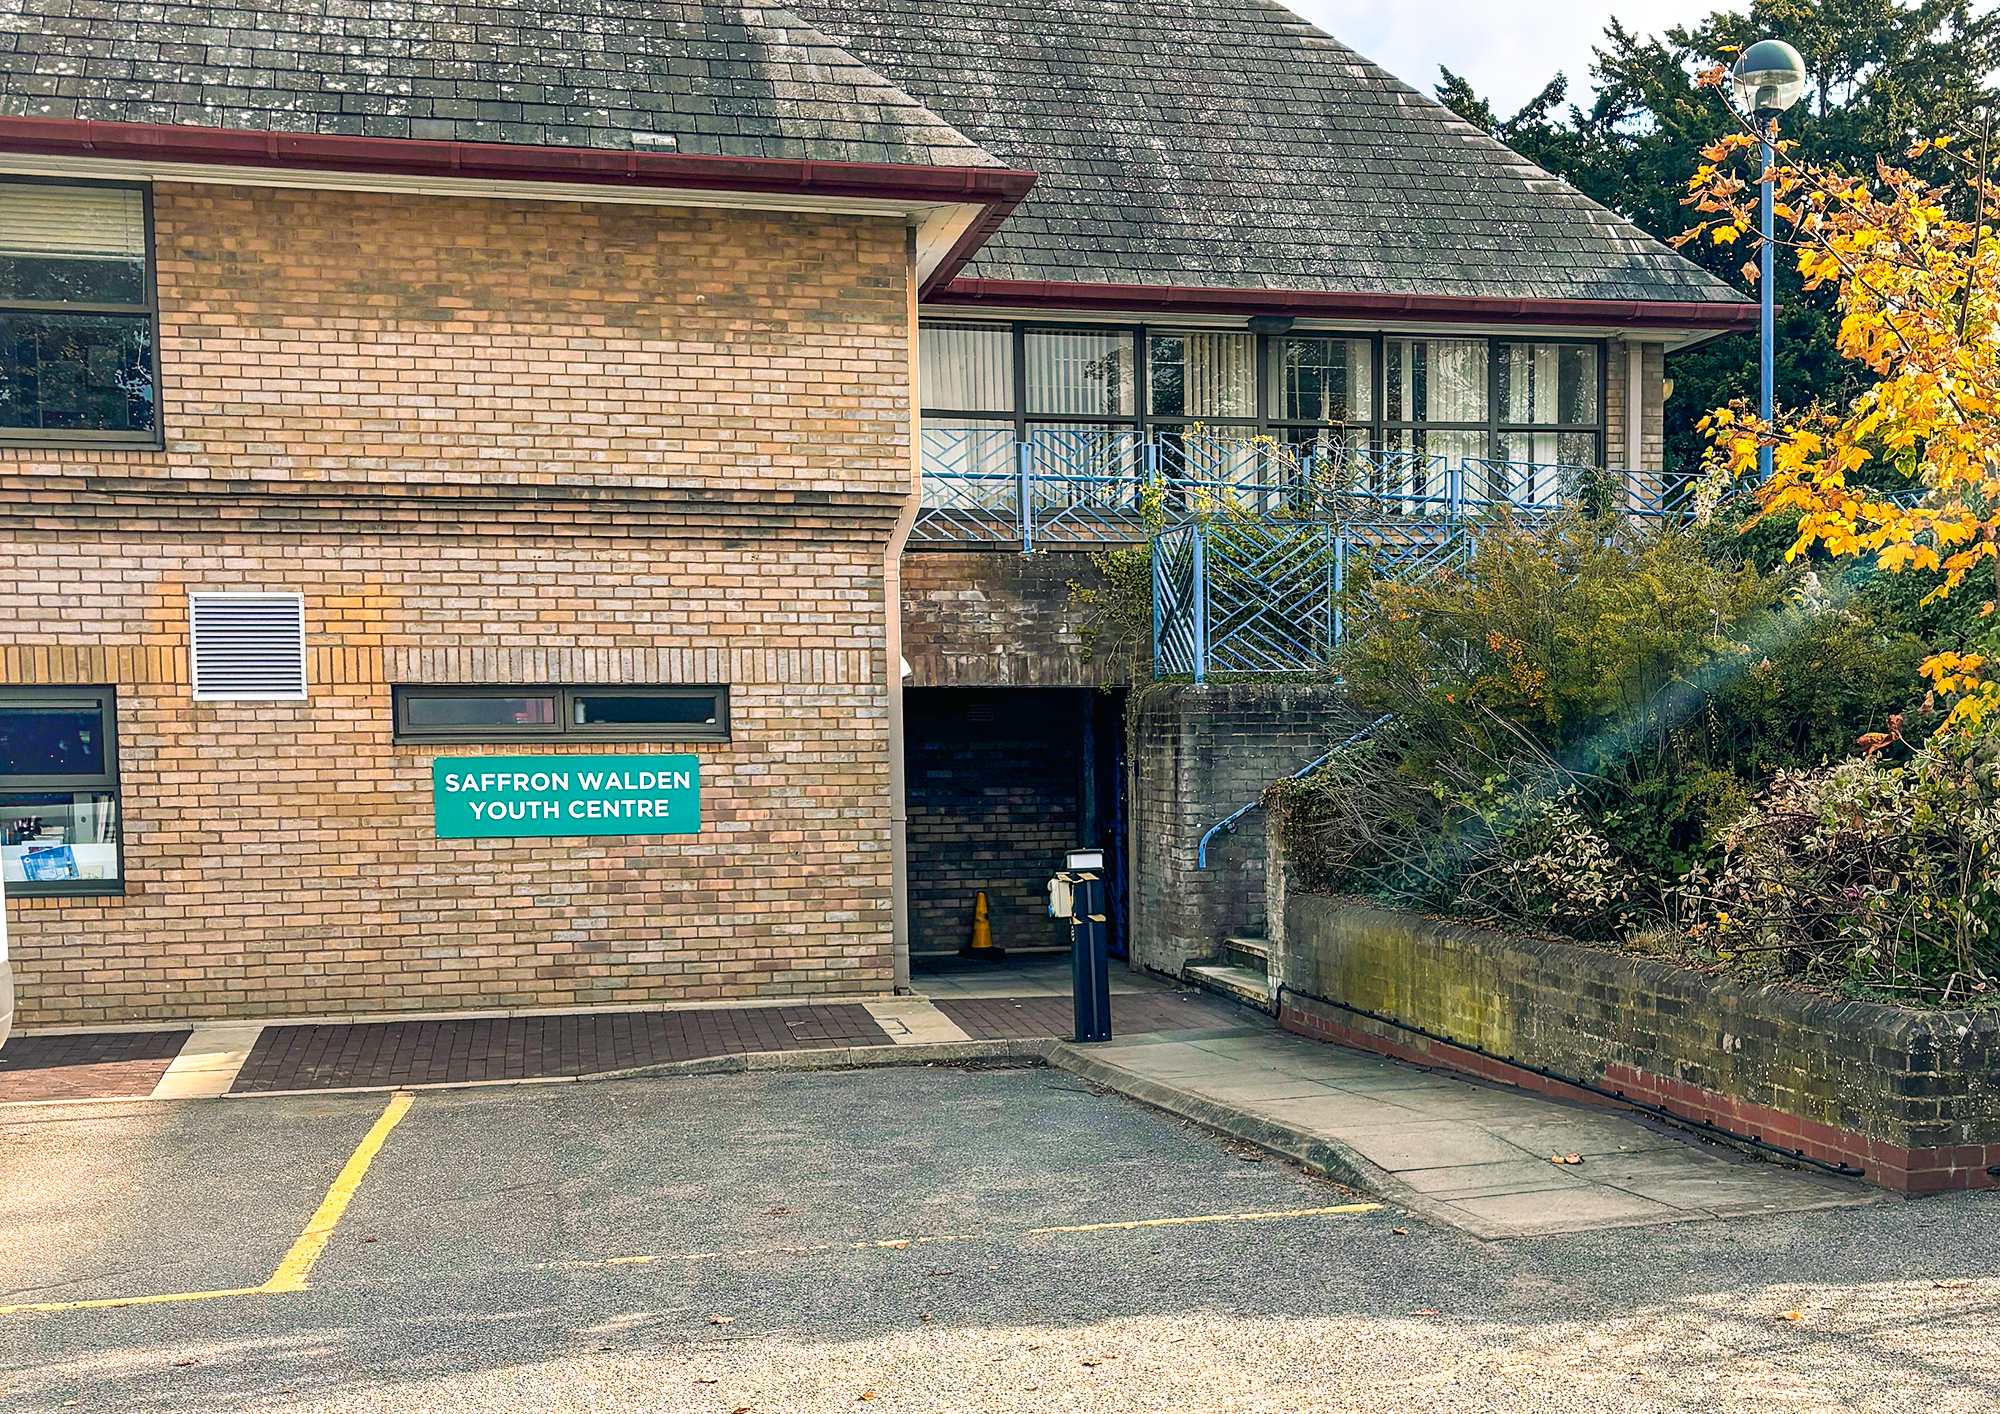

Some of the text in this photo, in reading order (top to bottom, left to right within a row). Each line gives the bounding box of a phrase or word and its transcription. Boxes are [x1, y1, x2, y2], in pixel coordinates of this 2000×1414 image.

[445, 771, 691, 792] SAFFRON WALDEN
[469, 799, 670, 820] YOUTH CENTRE
